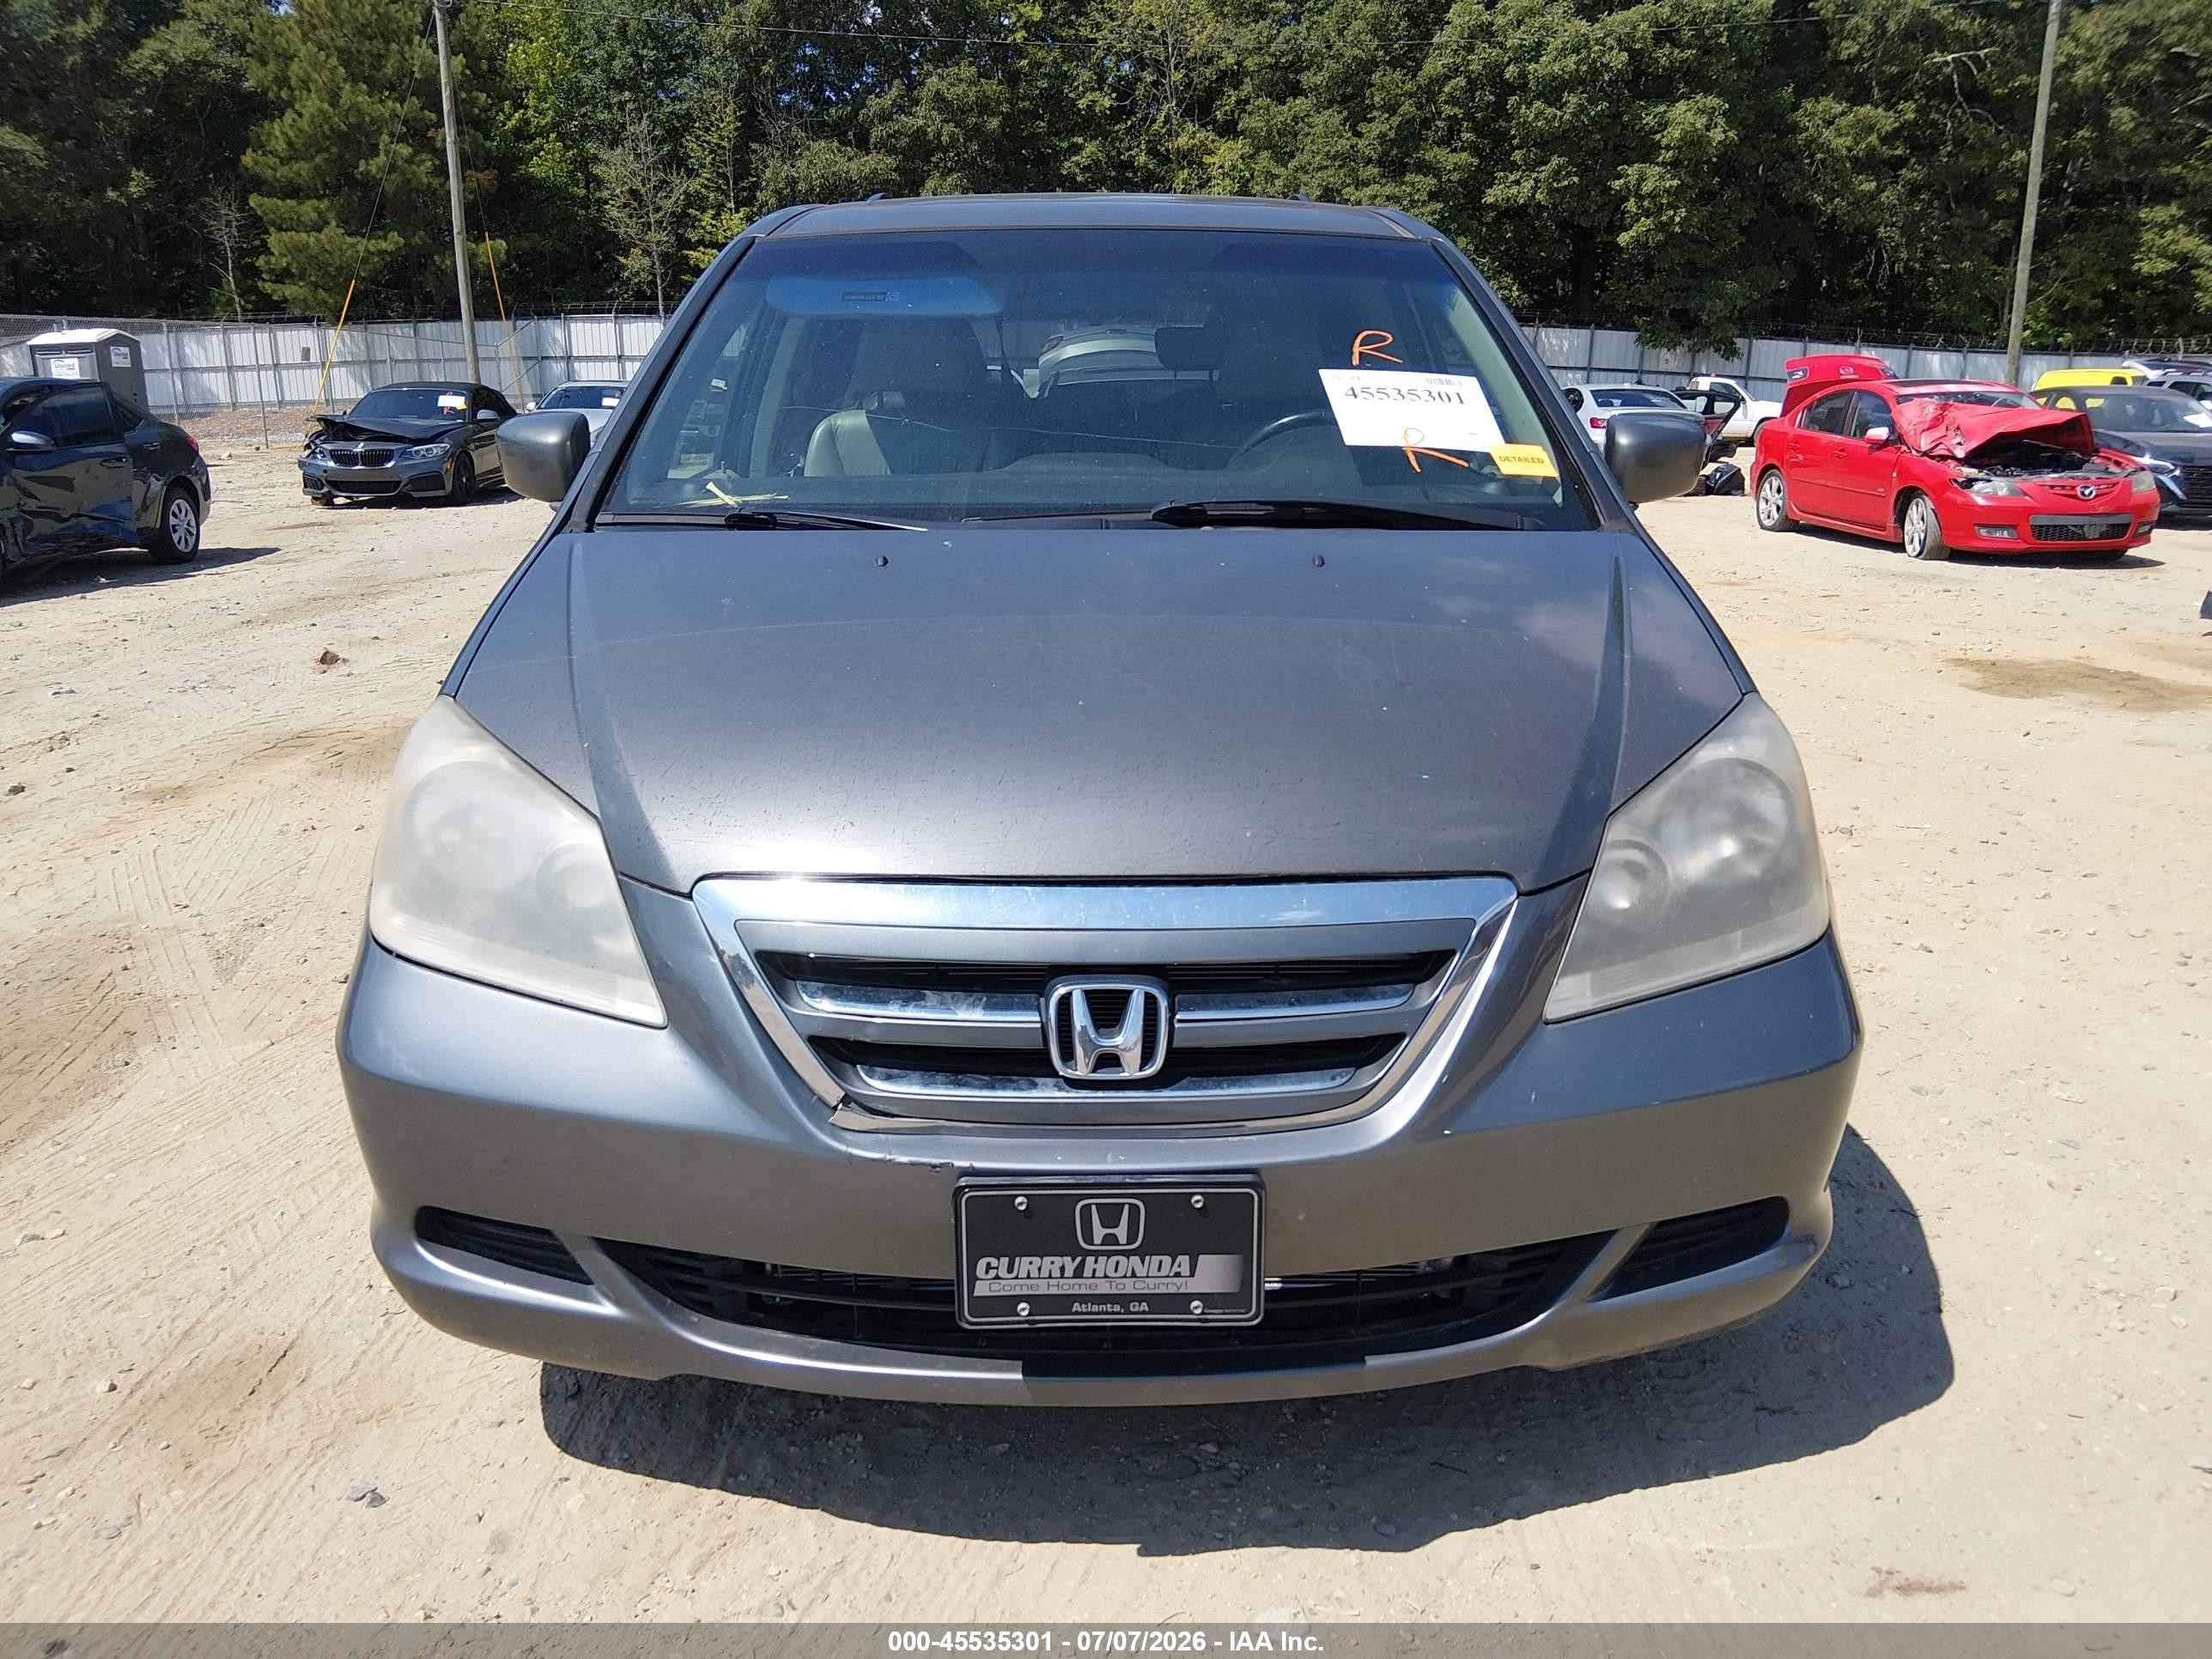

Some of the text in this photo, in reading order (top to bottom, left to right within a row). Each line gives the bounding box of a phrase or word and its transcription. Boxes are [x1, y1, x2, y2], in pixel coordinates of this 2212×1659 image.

[1352, 330, 1403, 366] R
[1344, 386, 1466, 404] 45535301
[1402, 428, 1470, 472] R
[1498, 455, 1545, 465] DETAILED
[975, 1255, 1190, 1279] CURRY HONDA
[988, 1279, 1188, 1292] Come Home To Curry!
[1072, 1301, 1149, 1314] Atlanta, GA
